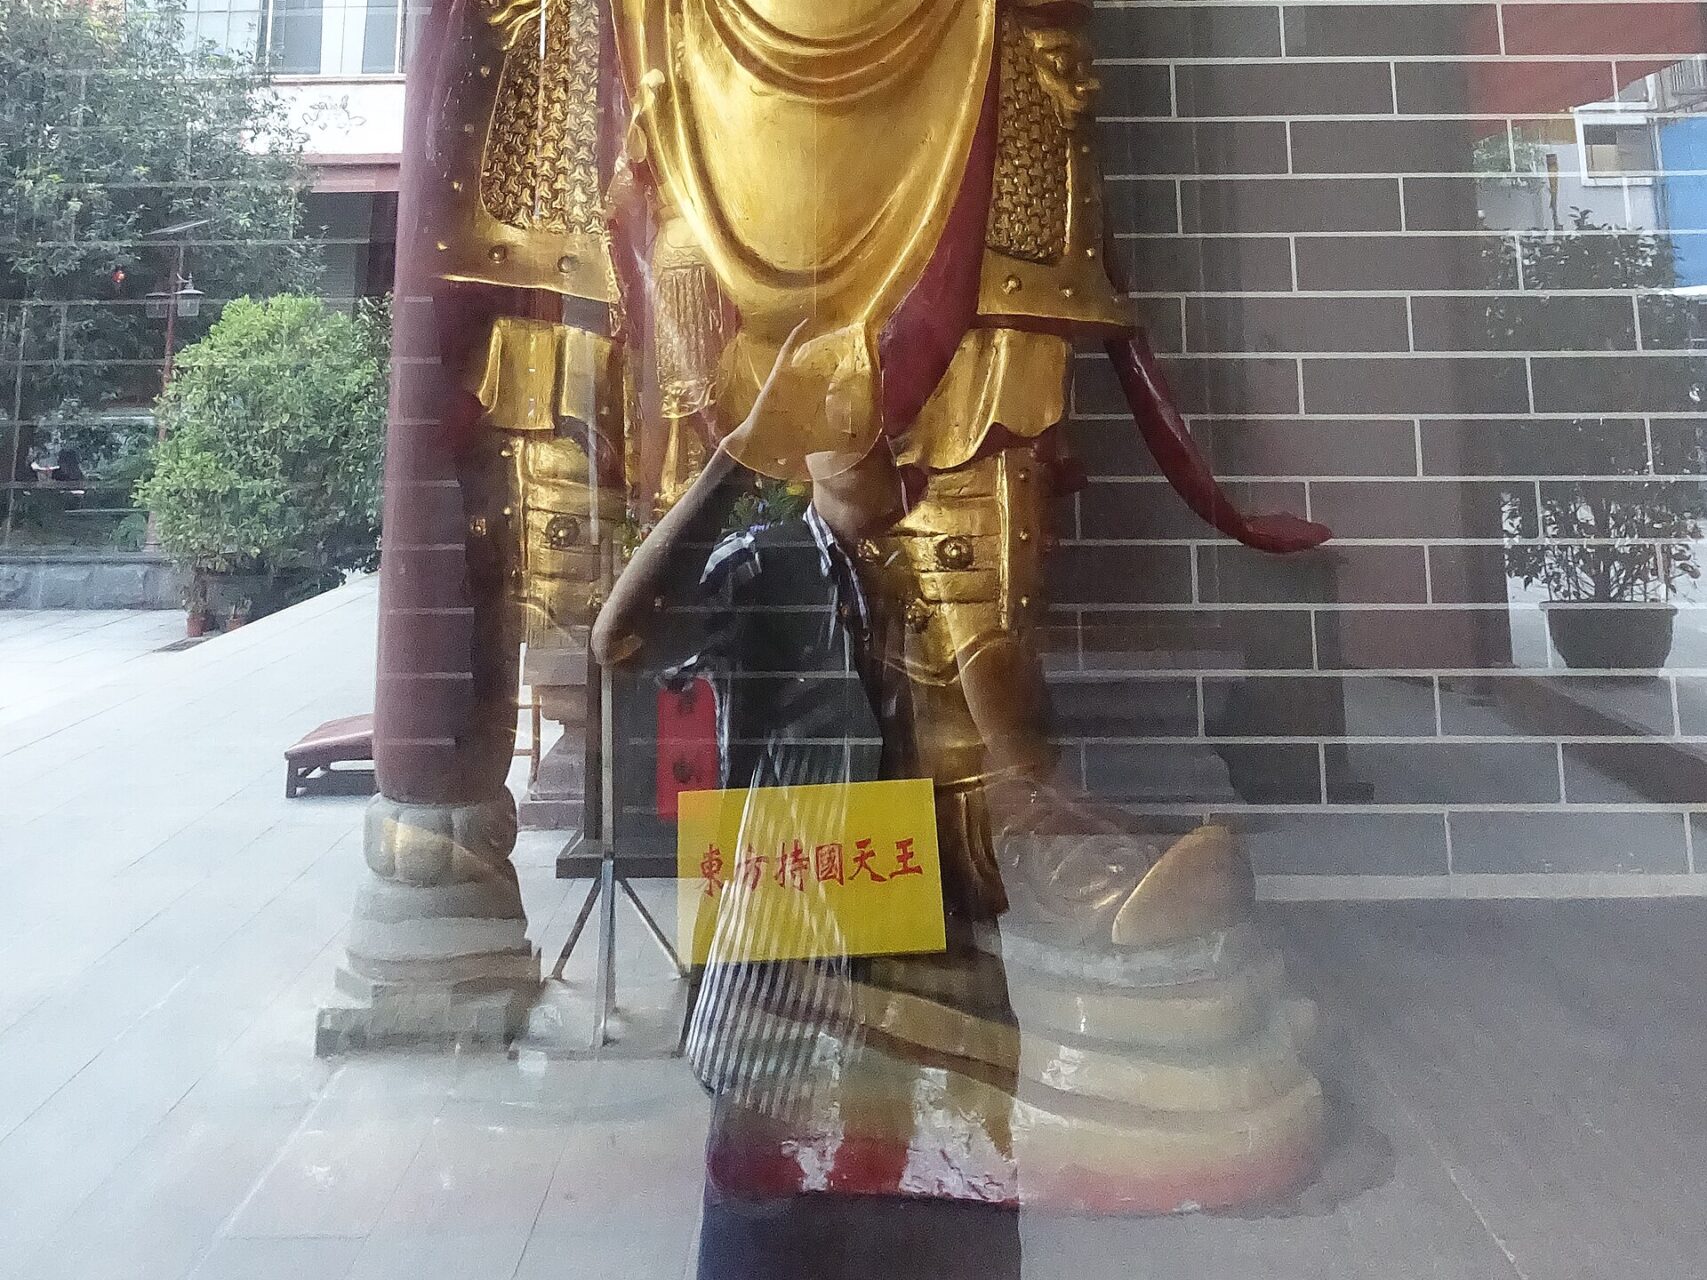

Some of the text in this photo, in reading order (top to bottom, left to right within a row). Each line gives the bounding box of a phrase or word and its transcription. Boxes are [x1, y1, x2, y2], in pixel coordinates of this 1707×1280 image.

[698, 837, 923, 898] 東方持國天王
